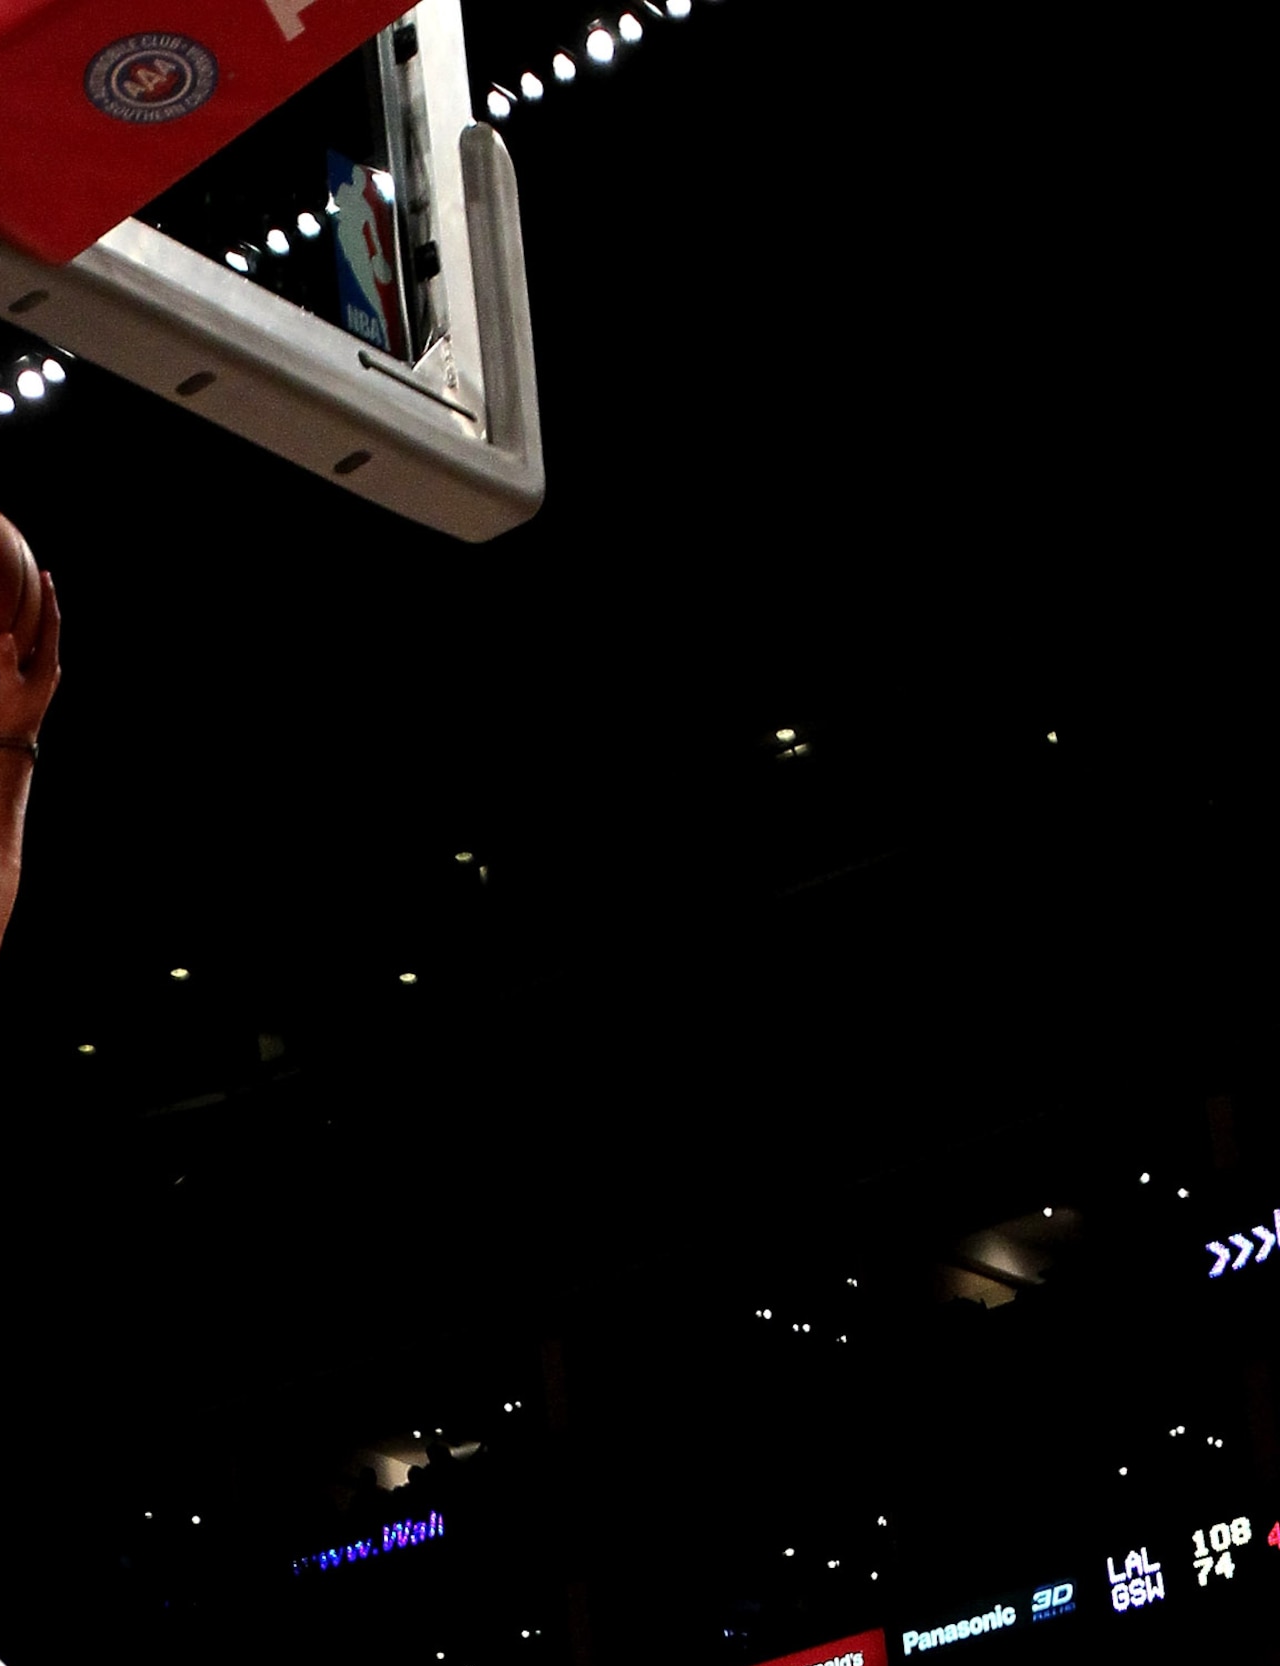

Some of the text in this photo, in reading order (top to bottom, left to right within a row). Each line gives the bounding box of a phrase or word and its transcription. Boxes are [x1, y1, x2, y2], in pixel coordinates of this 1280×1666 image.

[346, 303, 382, 346] NBA
[1106, 1516, 1252, 1585] LAL 108
[1031, 1583, 1073, 1613] 3D
[1111, 1550, 1236, 1613] GSW 74
[902, 1603, 1016, 1656] Panasonic
